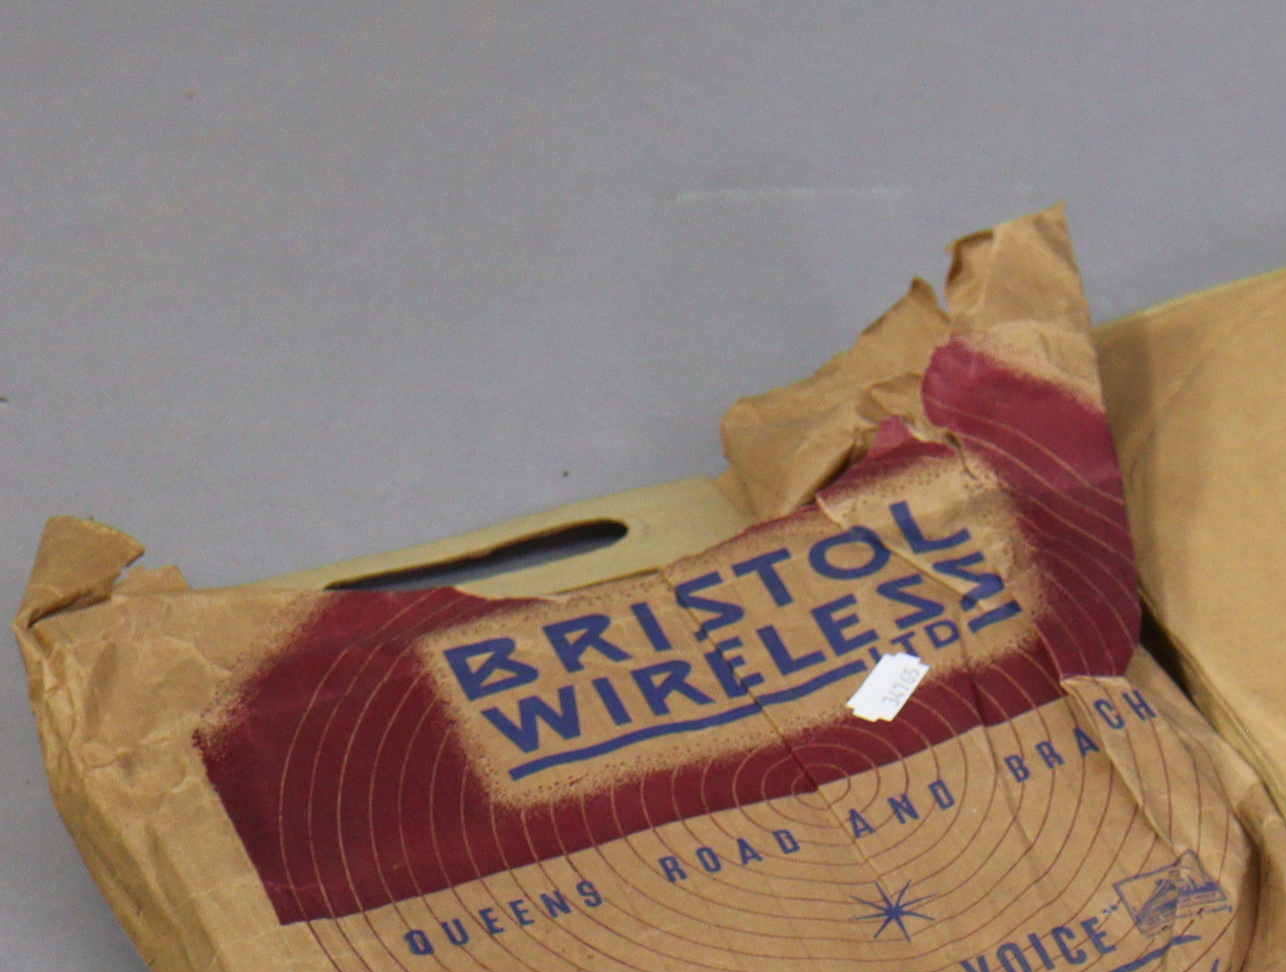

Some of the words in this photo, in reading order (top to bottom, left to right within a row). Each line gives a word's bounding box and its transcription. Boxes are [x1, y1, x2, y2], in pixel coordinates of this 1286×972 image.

[443, 501, 973, 699] BRISTOL
[482, 550, 1008, 753] WIRELESS
[403, 877, 603, 957] QUEENS
[658, 827, 800, 884] ROAD
[848, 778, 956, 839] AND
